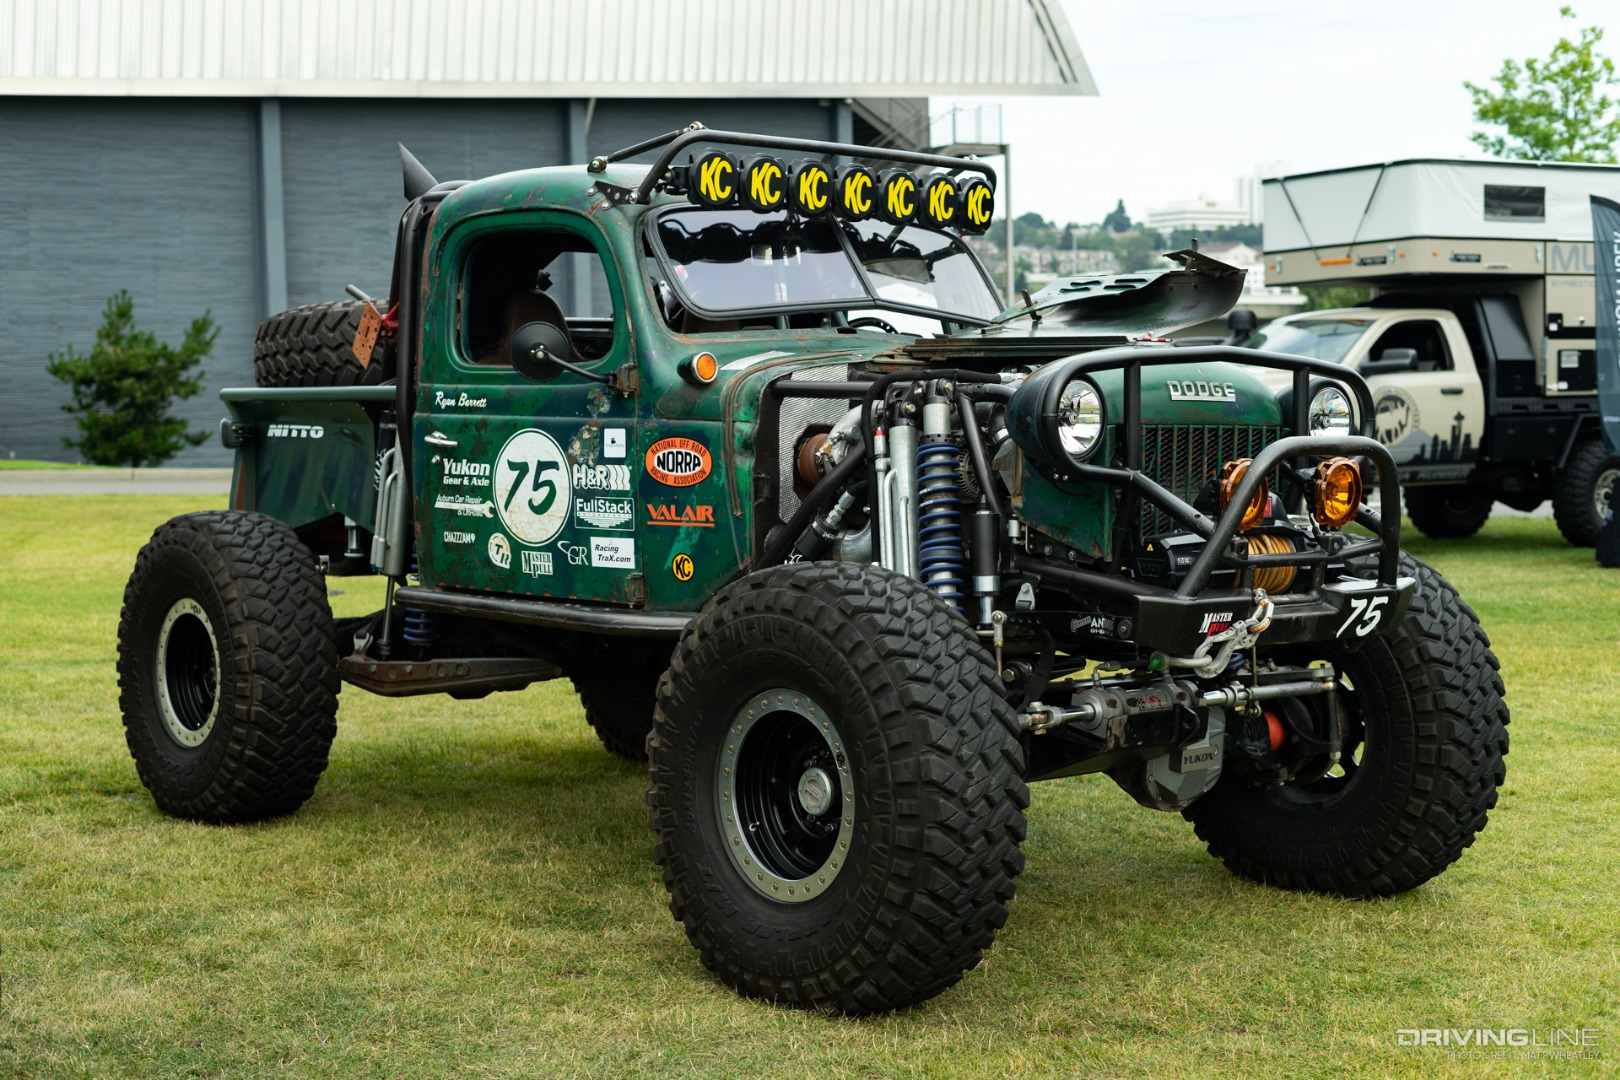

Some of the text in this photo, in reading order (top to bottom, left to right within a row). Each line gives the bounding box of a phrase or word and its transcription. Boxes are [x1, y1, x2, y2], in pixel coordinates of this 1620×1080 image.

[700, 157, 733, 201] KC
[751, 162, 782, 206] KC
[800, 167, 828, 210] KC
[845, 172, 873, 215] KC
[888, 177, 915, 218] KC
[929, 181, 955, 222] KC
[968, 185, 992, 225] KC
[1167, 380, 1236, 397] DODGE
[435, 391, 456, 409] Ryan
[267, 424, 325, 439] NITTO
[650, 439, 707, 457] NATIONAL OFF ROAD
[443, 458, 490, 476] Yukon
[656, 450, 702, 474] NORRA
[443, 476, 490, 487] Gear & Axle
[573, 464, 613, 490] H&R
[650, 466, 707, 485] RACING ASSOCIATION
[503, 459, 560, 516] 75
[455, 495, 465, 503] Car
[465, 496, 483, 504] Repair
[576, 498, 632, 514] FullStack
[646, 503, 715, 521] VALAIR
[595, 544, 619, 553] Racing
[598, 554, 631, 563] TraX.com
[522, 551, 552, 572] MASTER
[532, 563, 553, 577] PULL
[675, 555, 691, 579] KC
[1198, 612, 1233, 633] MASTER
[1336, 596, 1389, 638] 75
[1183, 751, 1216, 765] YUKON
